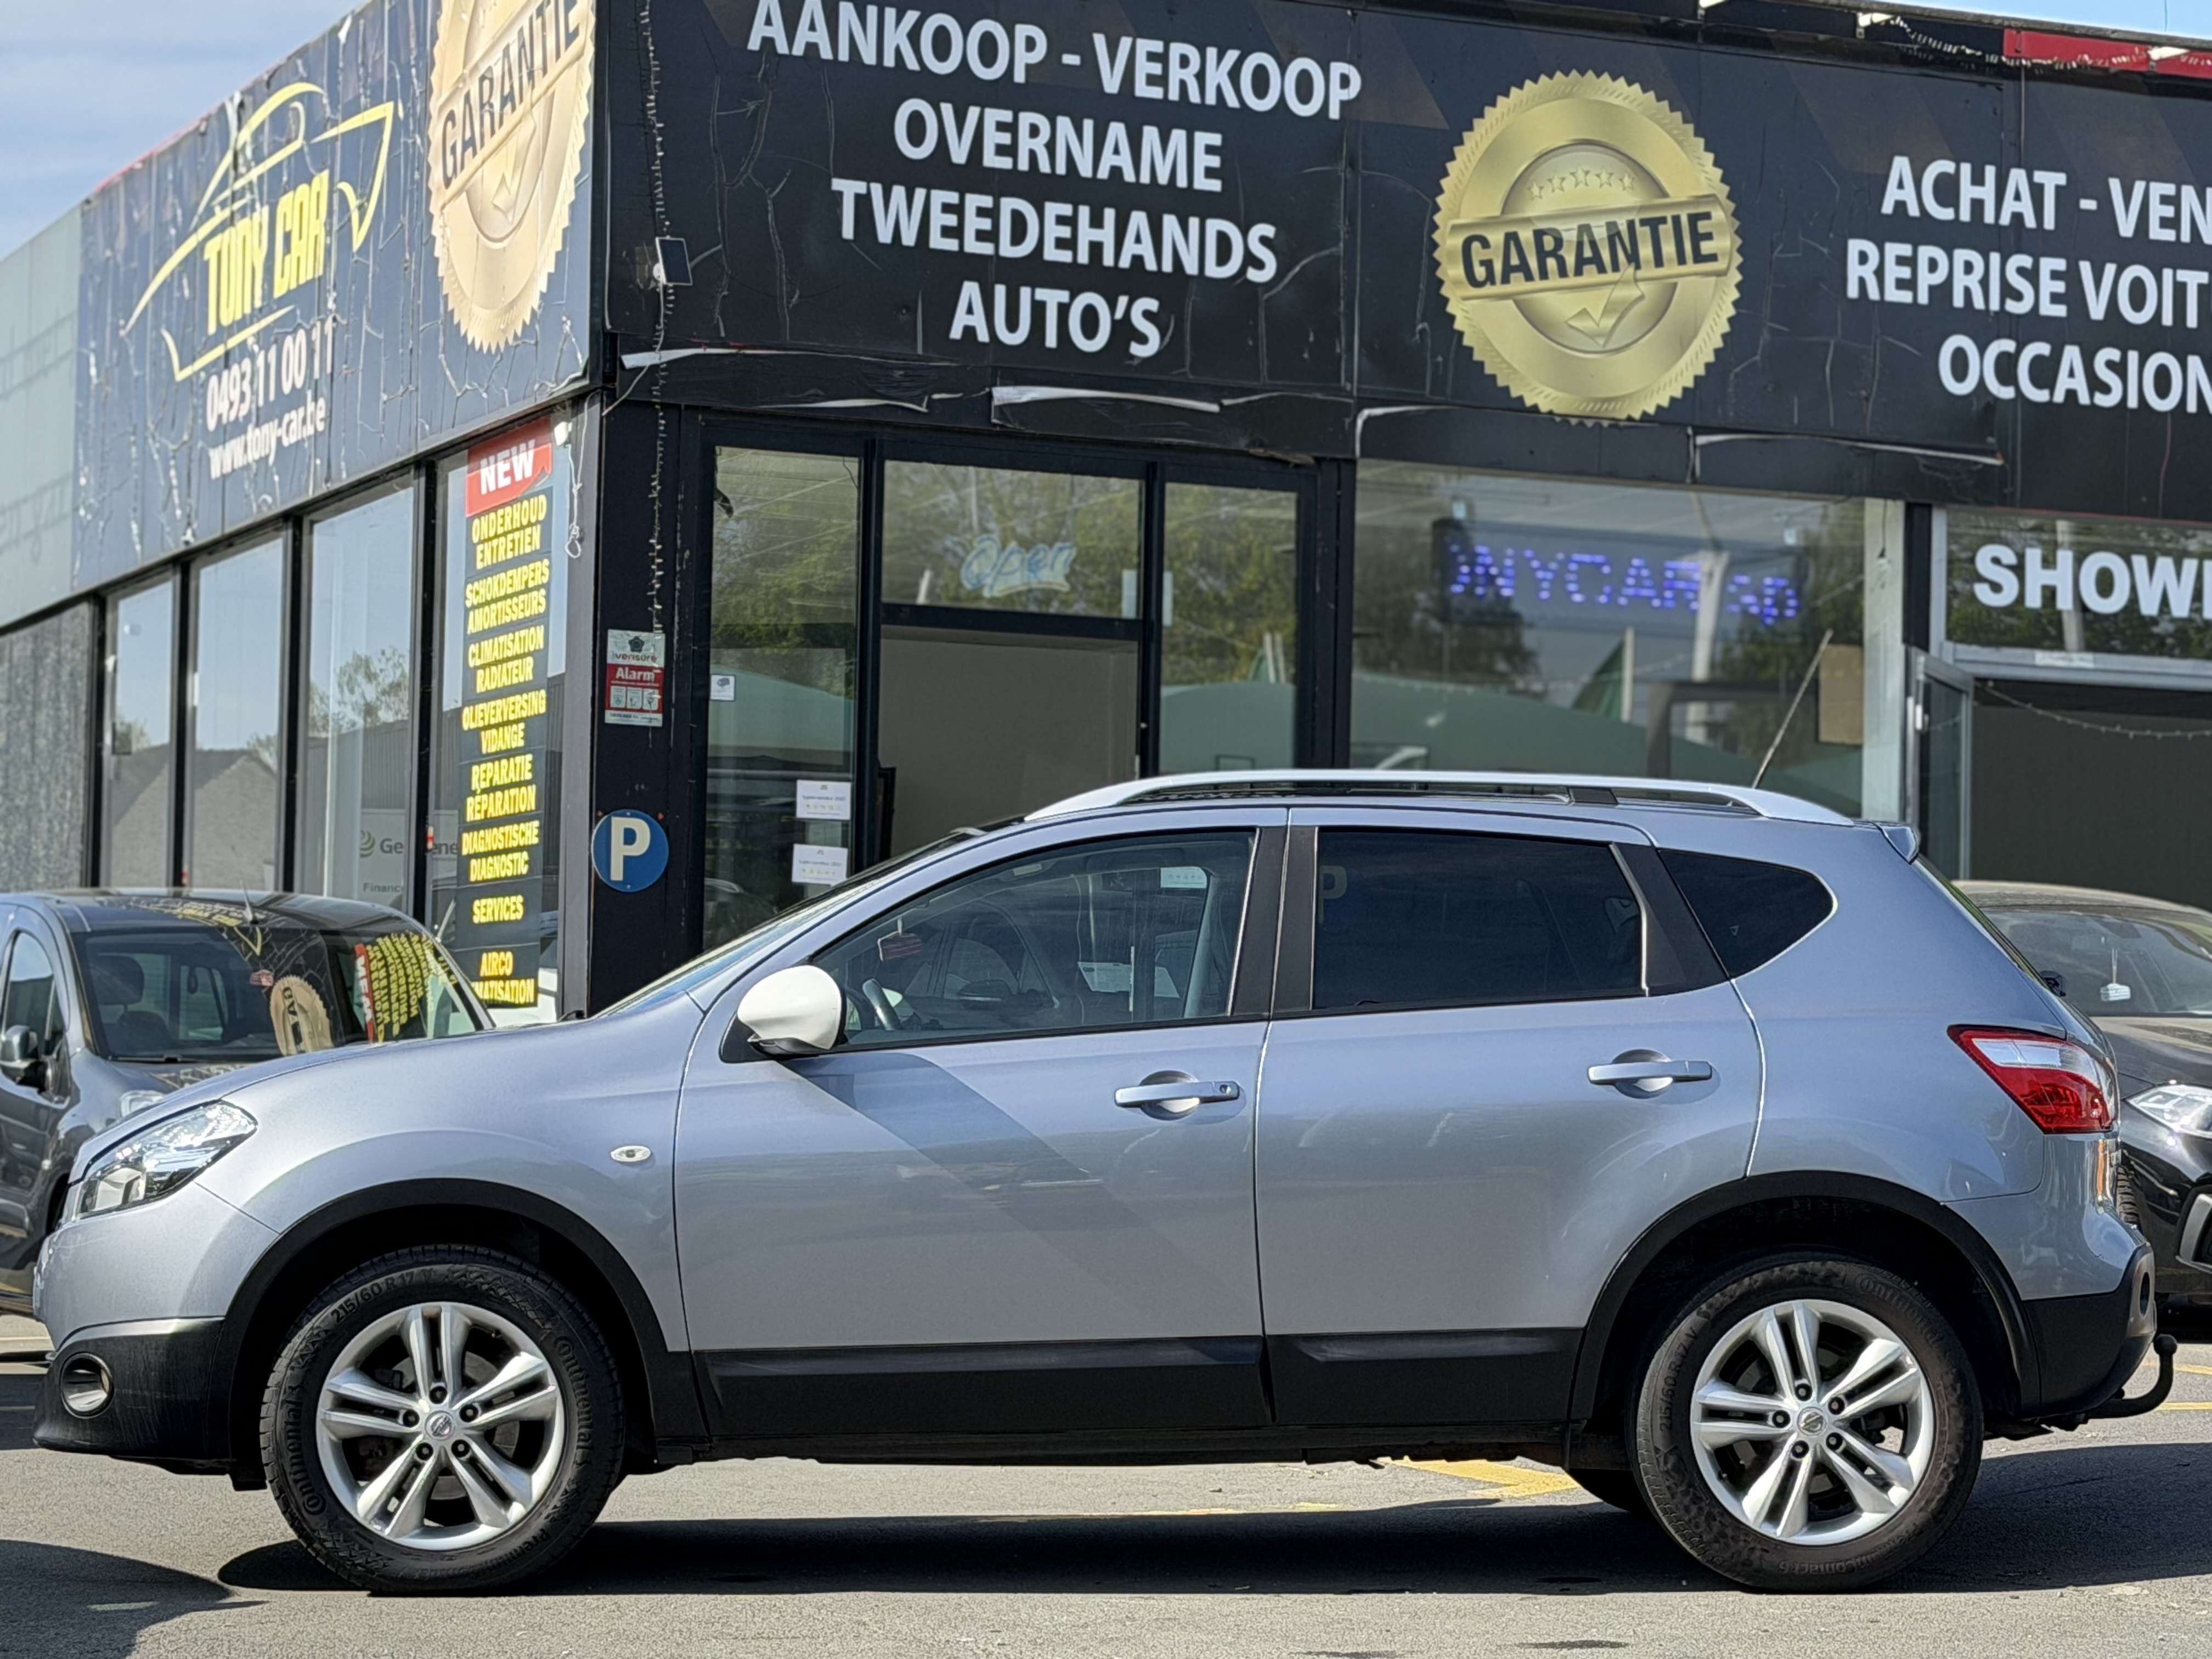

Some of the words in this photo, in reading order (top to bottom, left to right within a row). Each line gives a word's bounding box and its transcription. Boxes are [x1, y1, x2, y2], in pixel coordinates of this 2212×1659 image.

[747, 0, 1047, 83] AANKOOP
[1092, 33, 1362, 120] VERKOOP
[441, 0, 580, 190] GARANTIE
[894, 98, 1223, 192] OVERNAME
[1881, 155, 2067, 230] ACHAT
[203, 204, 269, 336] TONY
[273, 168, 330, 299] CAR
[831, 177, 1278, 284] TWEEDEHANDS
[1460, 210, 1720, 289] GARANTIE
[1846, 238, 2068, 318] REPRISE
[2079, 260, 2210, 329] VOIT
[949, 280, 1163, 358] AUTO'S
[206, 357, 252, 432] 0493
[256, 343, 277, 407] 11
[281, 329, 307, 395] 00
[311, 314, 334, 380] 11
[1938, 333, 2212, 415] OCCASION
[479, 439, 535, 495] NEW
[472, 494, 548, 544] ONDERHOUD
[476, 524, 541, 570] ENTRETIEN
[465, 558, 550, 608] SCHOKDEMPERS
[1973, 543, 2212, 620] SHOW
[466, 588, 547, 635] AMORTISSEURS
[468, 624, 545, 668] CLIMATISATION
[476, 656, 534, 693] RADIATEUR
[616, 667, 655, 682] Alarm
[461, 689, 547, 731] OLIEVERVERSING
[481, 722, 526, 754] VIDANGE
[471, 753, 533, 791] REPARATIE
[462, 820, 540, 856] DIAGNOSTISCHE
[610, 816, 651, 881] P
[470, 850, 530, 882] DIAGNOSTIC
[472, 894, 524, 924] SERVICES
[479, 951, 514, 978] AIRCO
[471, 978, 535, 1005] MATISATION
[330, 1282, 383, 1324] 215/60
[554, 1335, 593, 1451] Continental
[284, 1400, 326, 1516] Continental
